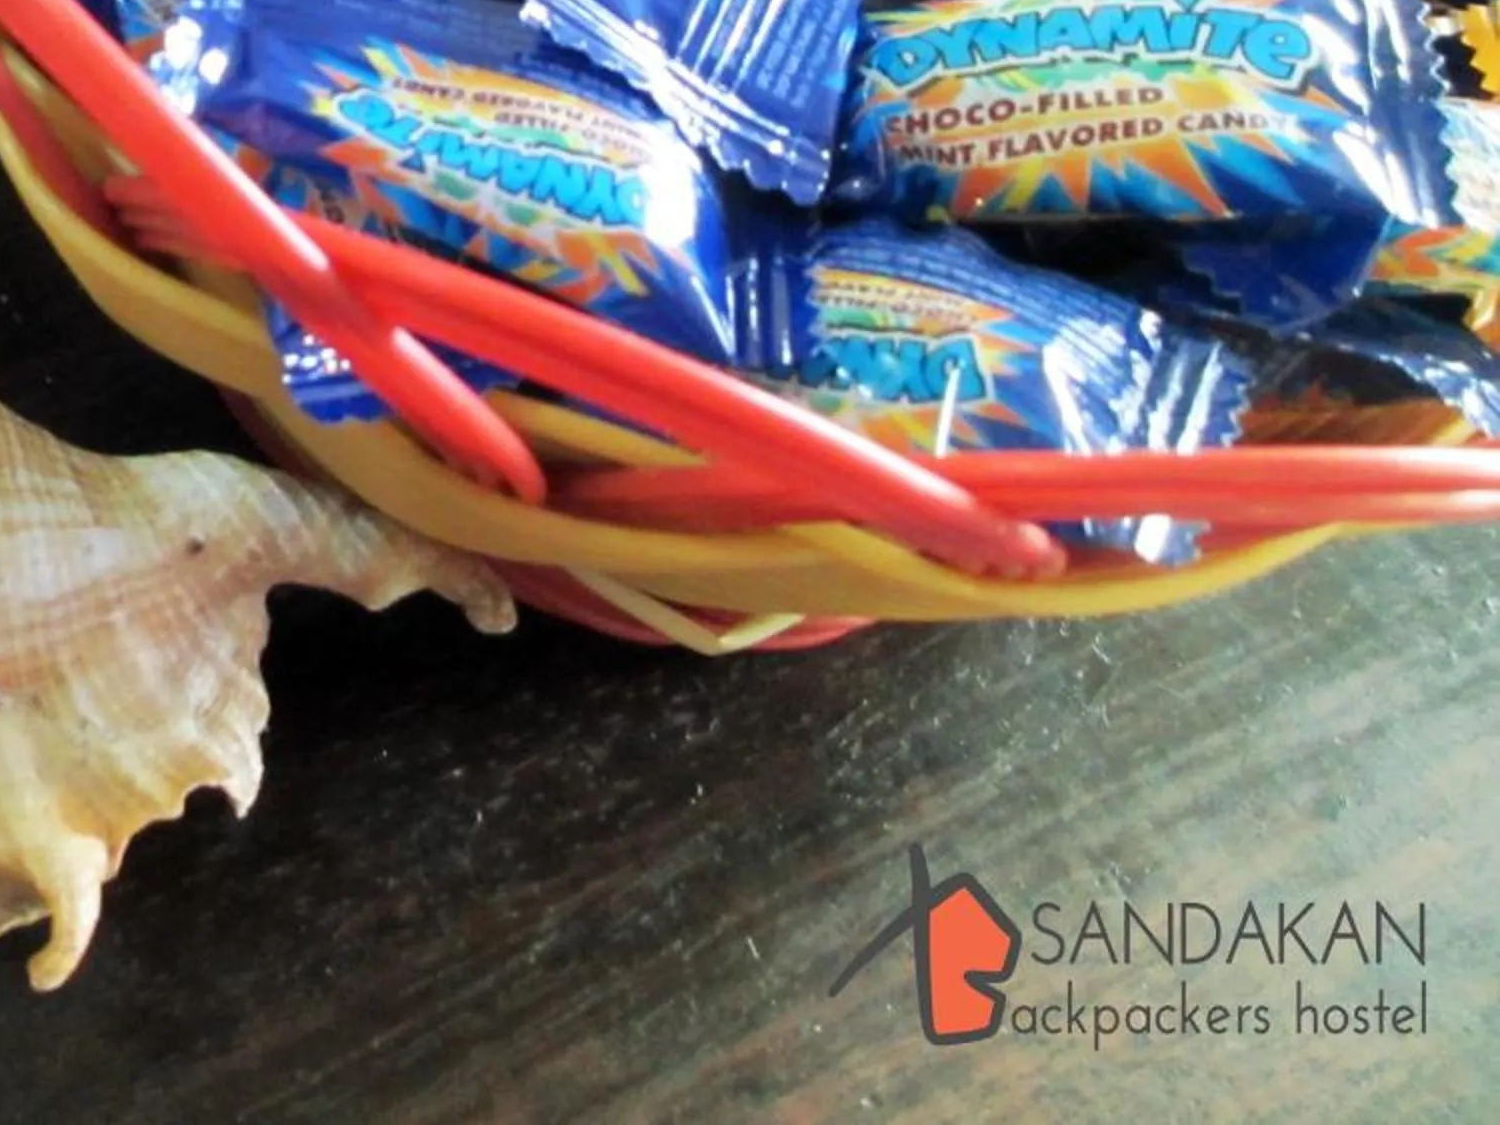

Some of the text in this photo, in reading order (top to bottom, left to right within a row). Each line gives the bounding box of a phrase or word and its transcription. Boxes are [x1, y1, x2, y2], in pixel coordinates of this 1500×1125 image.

[886, 87, 1164, 135] CHOCO-FILLED
[900, 142, 976, 165] MINT
[988, 117, 1164, 161] FLAVORED
